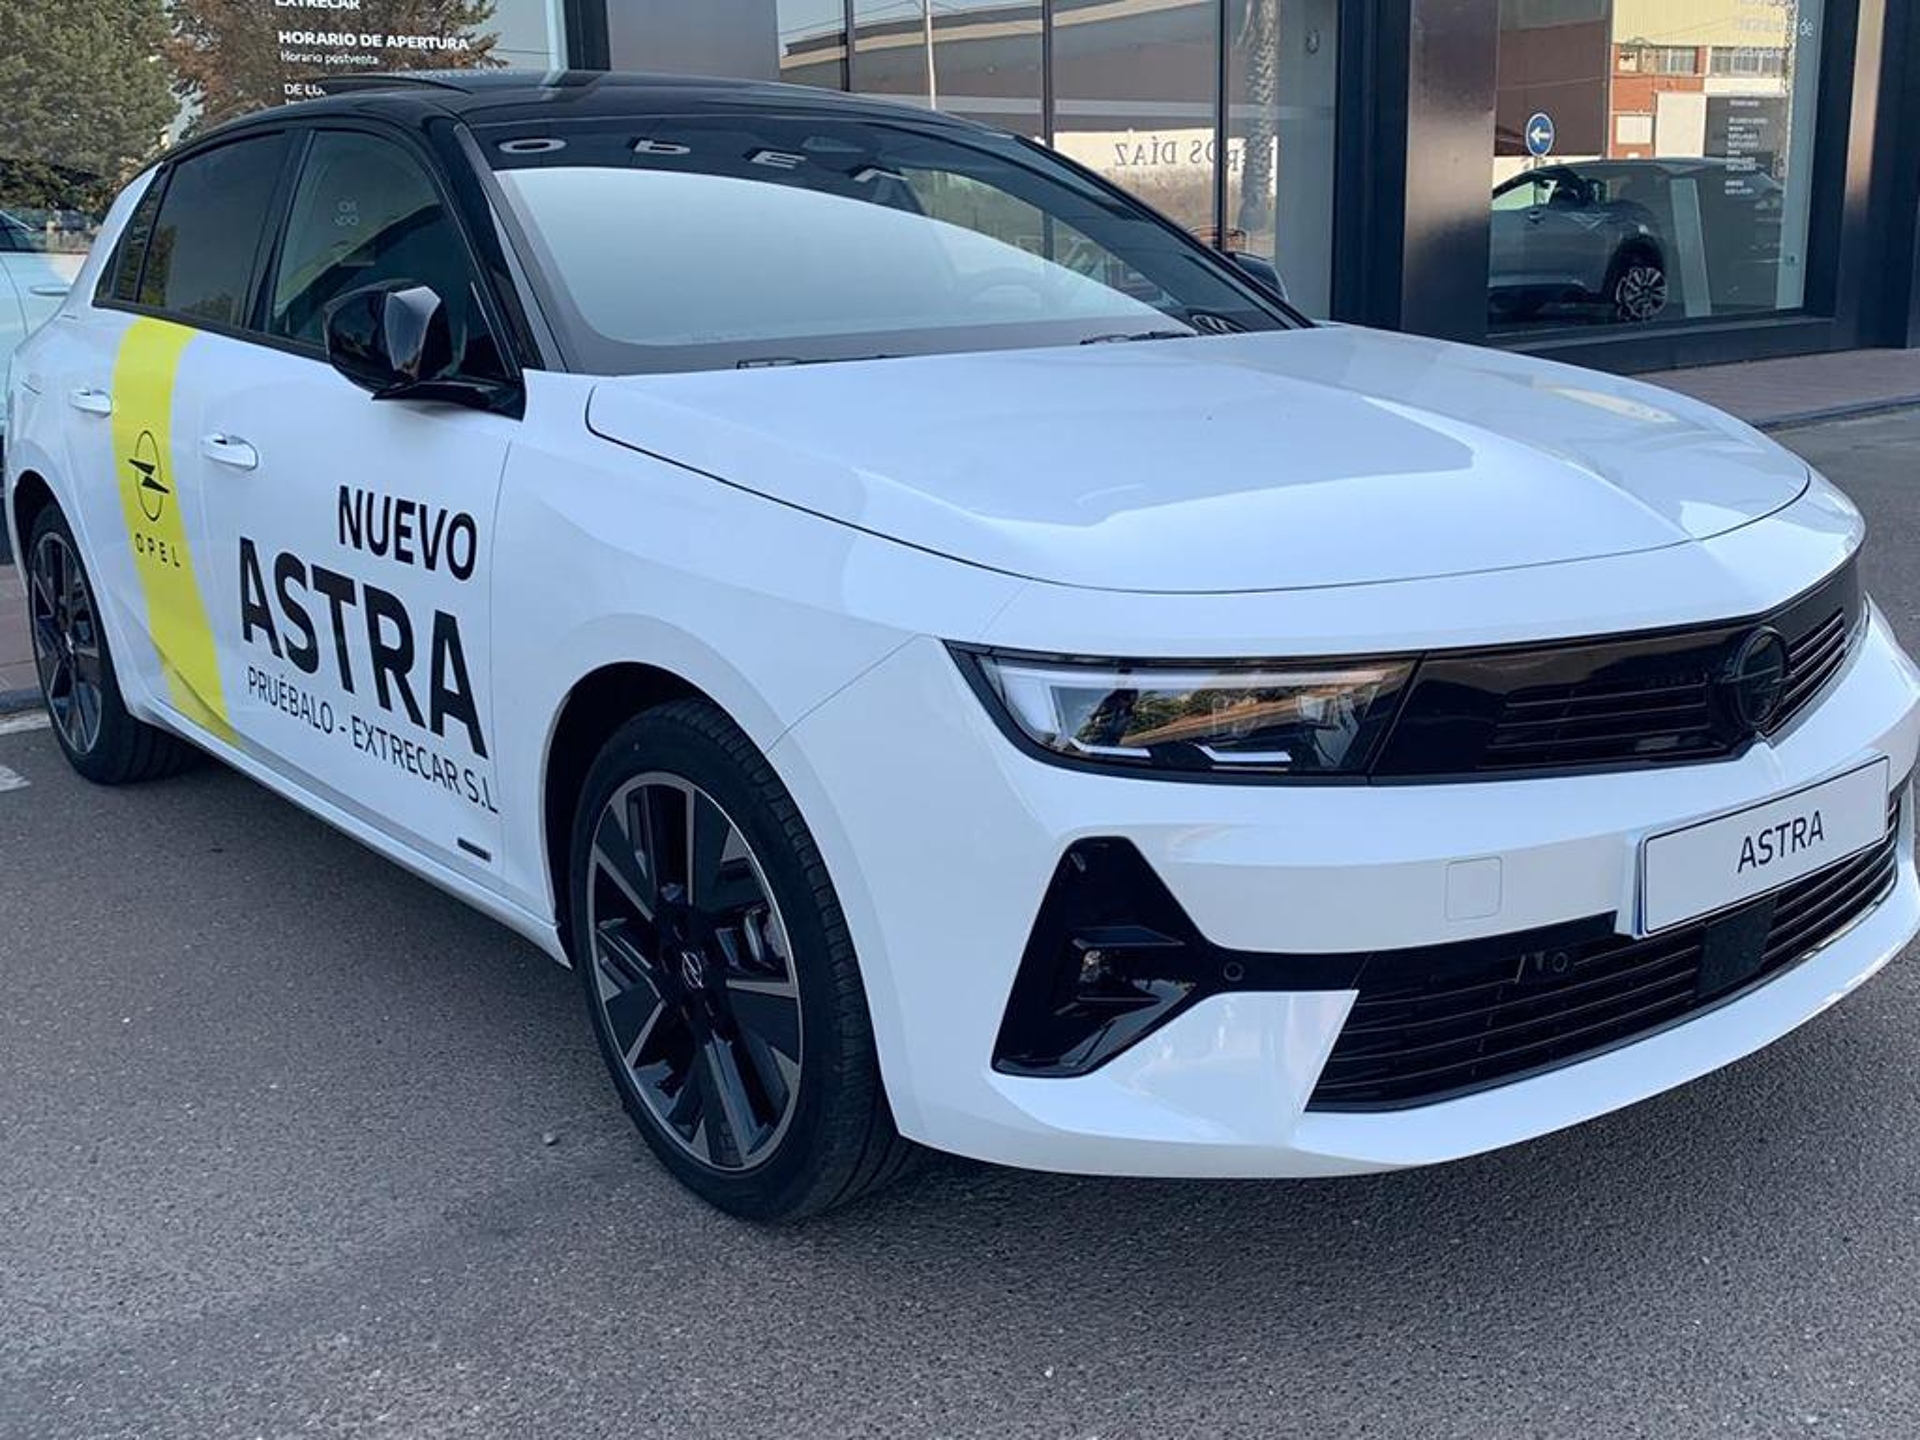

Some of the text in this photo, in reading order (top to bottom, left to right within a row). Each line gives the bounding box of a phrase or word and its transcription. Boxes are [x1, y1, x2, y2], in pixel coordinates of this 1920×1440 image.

[278, 31, 470, 50] HORARIO DE APERTURA
[280, 50, 380, 66] Horario postventa
[284, 83, 302, 95] DE
[135, 532, 181, 568] OPEL
[338, 485, 478, 580] NUEVO
[239, 536, 490, 760] ASTRA
[247, 666, 335, 736] PRUÉBALO
[351, 715, 462, 794] EXTRECAR
[1737, 810, 1824, 873] ASTRA
